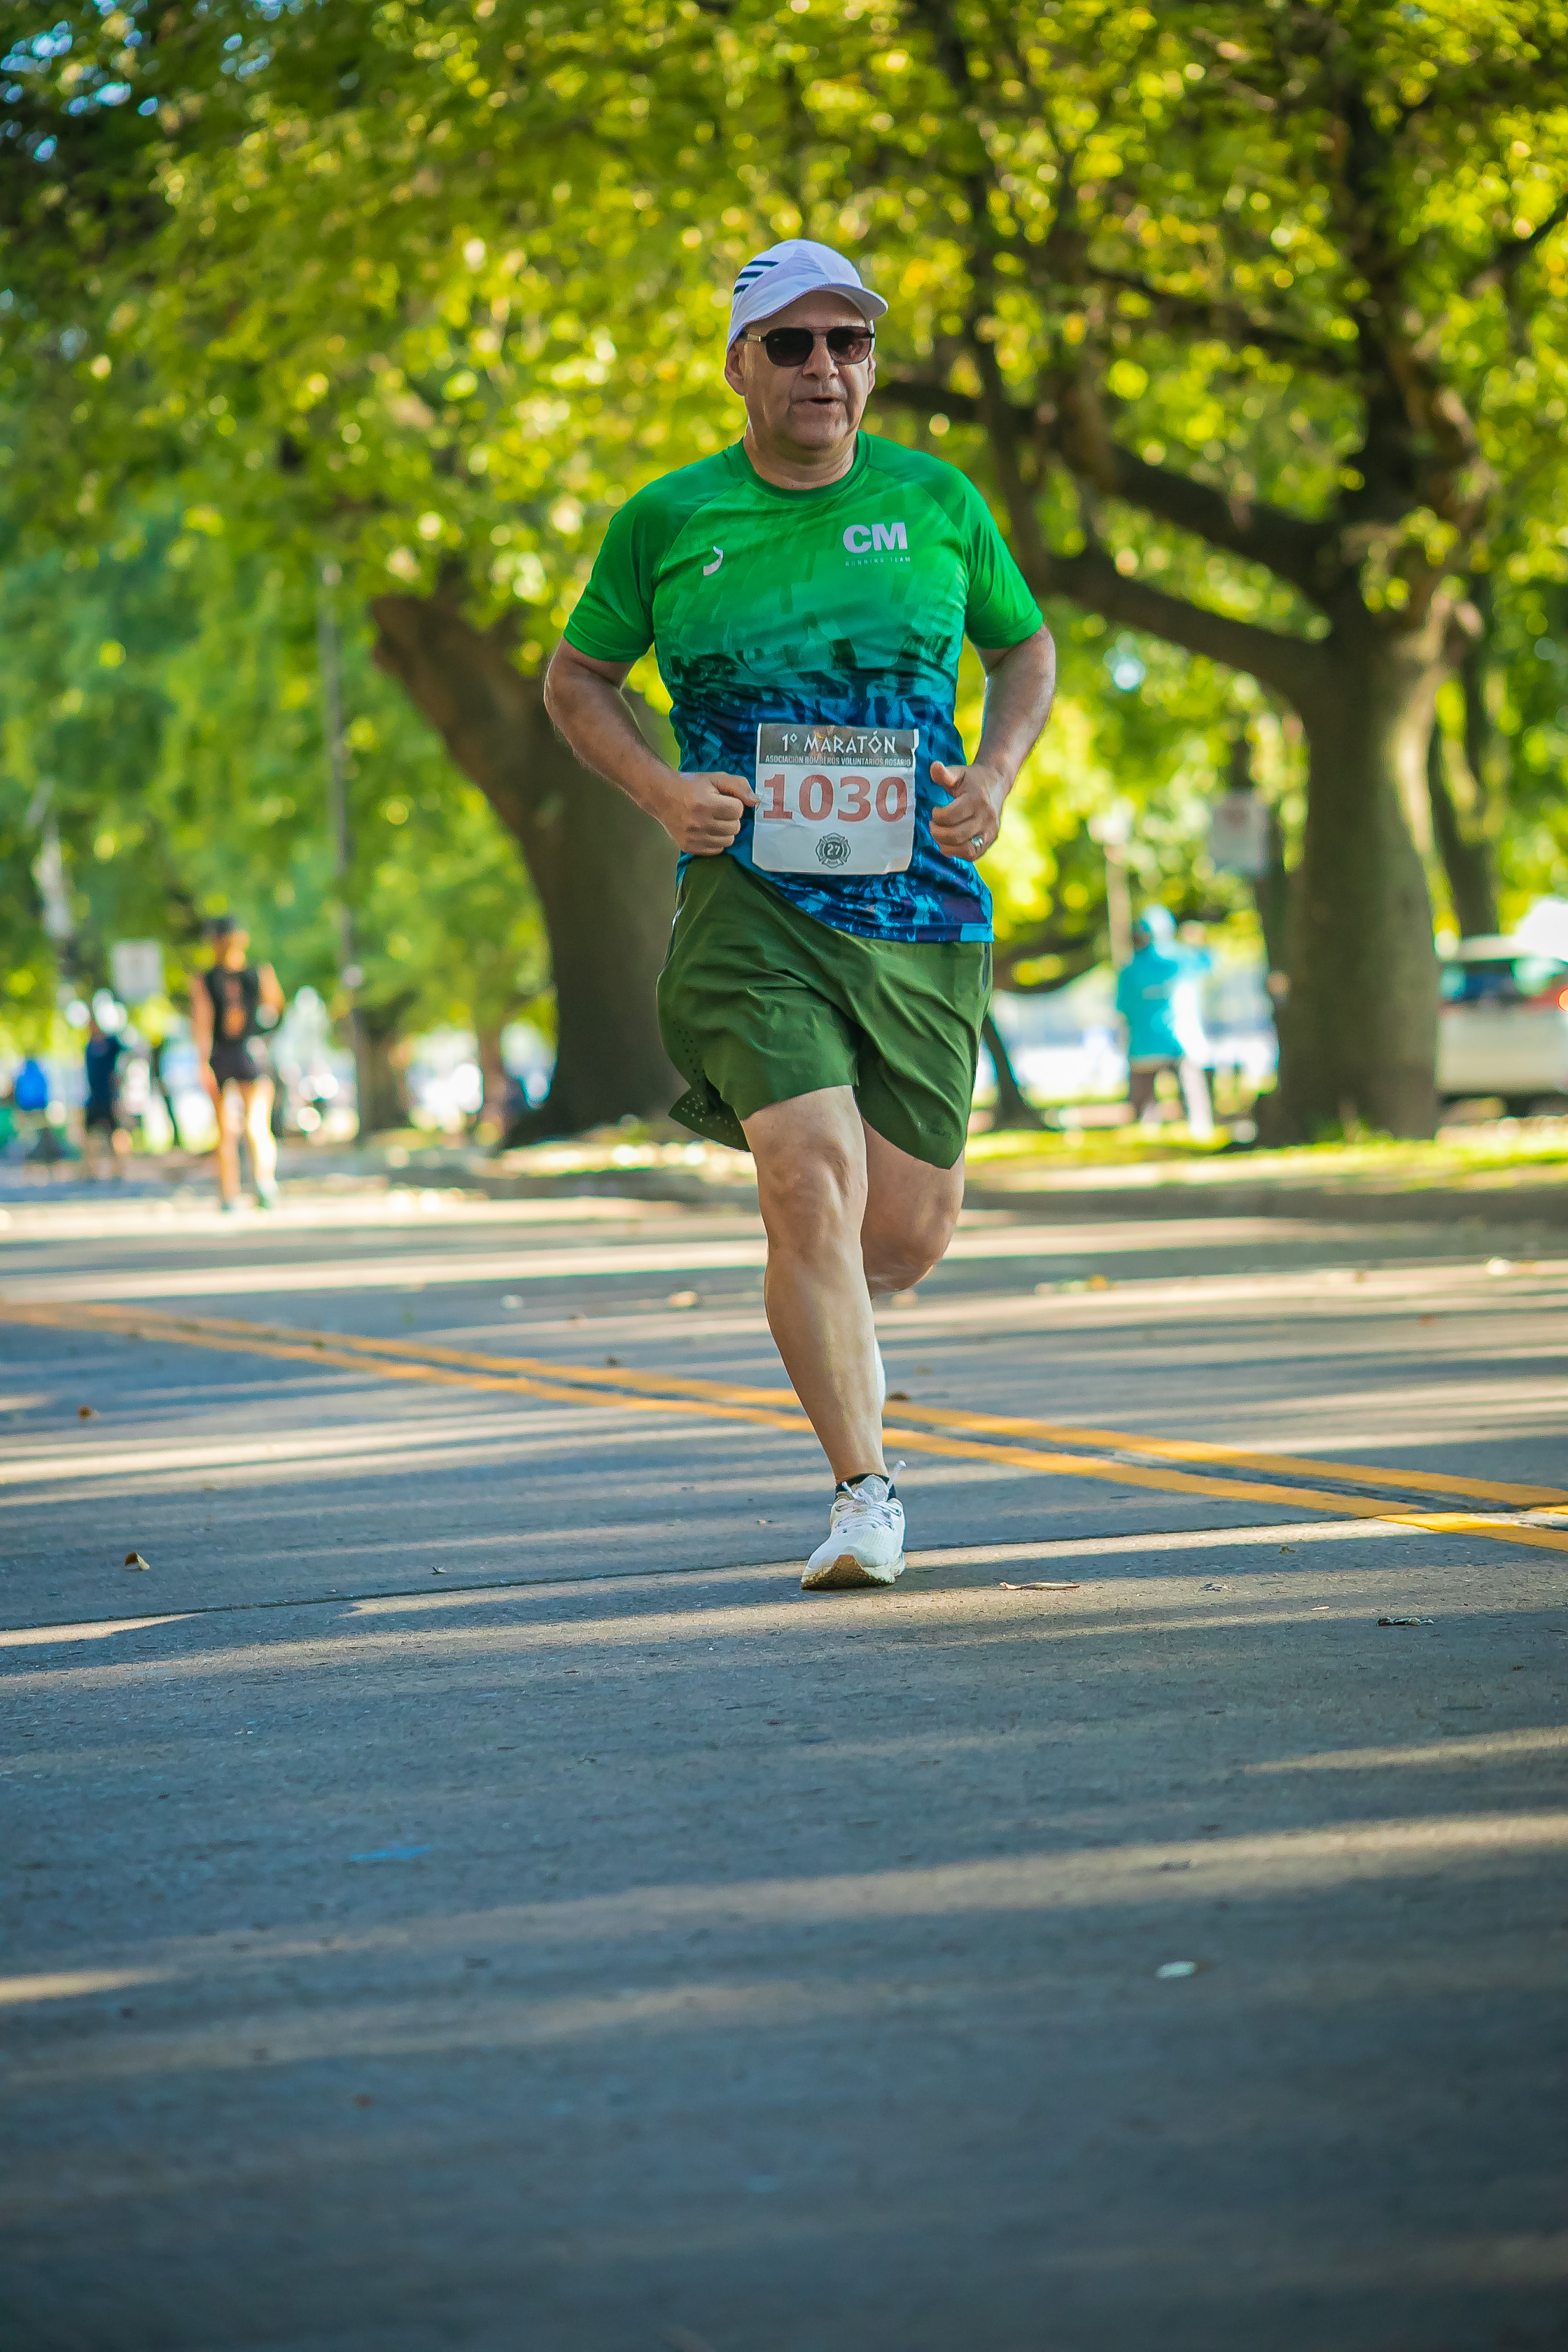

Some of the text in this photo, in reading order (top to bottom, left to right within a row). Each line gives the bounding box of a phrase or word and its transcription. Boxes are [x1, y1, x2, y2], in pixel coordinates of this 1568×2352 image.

[843, 522, 908, 554] CM
[804, 729, 896, 754] MARATÓN
[841, 757, 883, 766] VOLUNTARIOS
[884, 758, 911, 766] ROSARIO
[762, 774, 908, 822] 1030
[827, 844, 841, 855] 27
